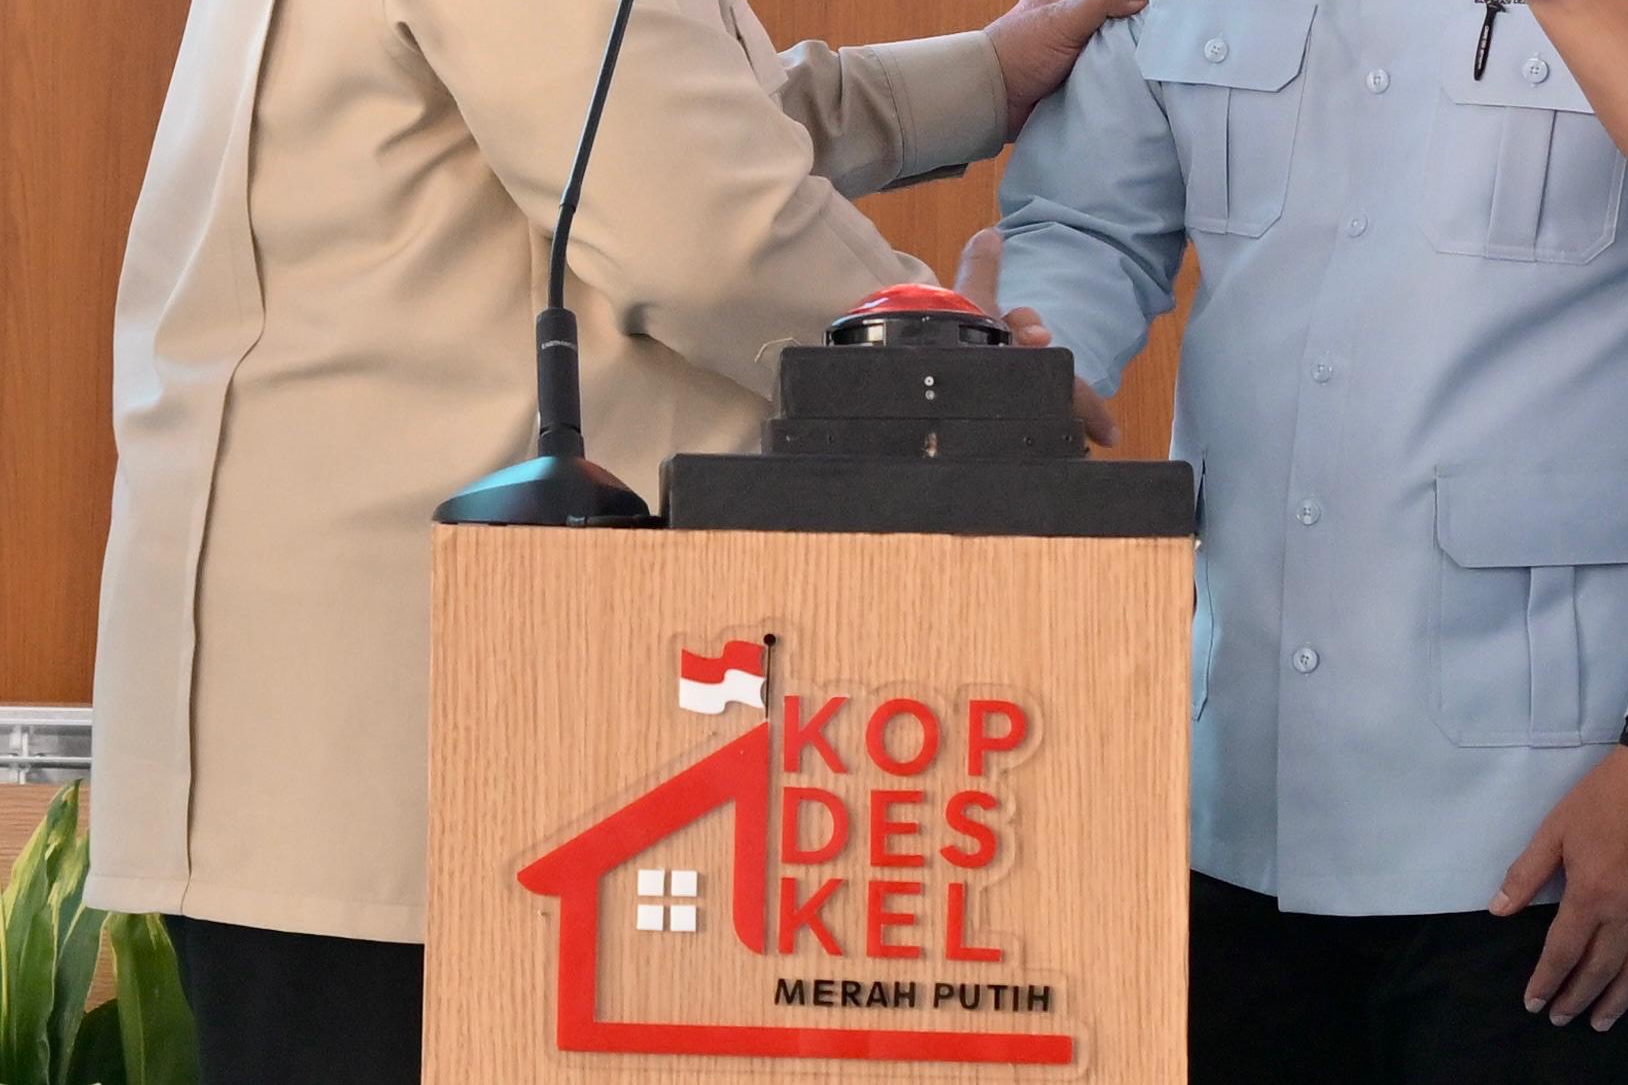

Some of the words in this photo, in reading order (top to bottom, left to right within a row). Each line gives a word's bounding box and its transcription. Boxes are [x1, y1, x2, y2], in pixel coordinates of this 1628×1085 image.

[784, 695, 1027, 777] KOP
[781, 786, 998, 869] DES
[778, 877, 1002, 962] KEL
[774, 978, 917, 1008] MERAH
[933, 982, 1050, 1012] PUTIH
